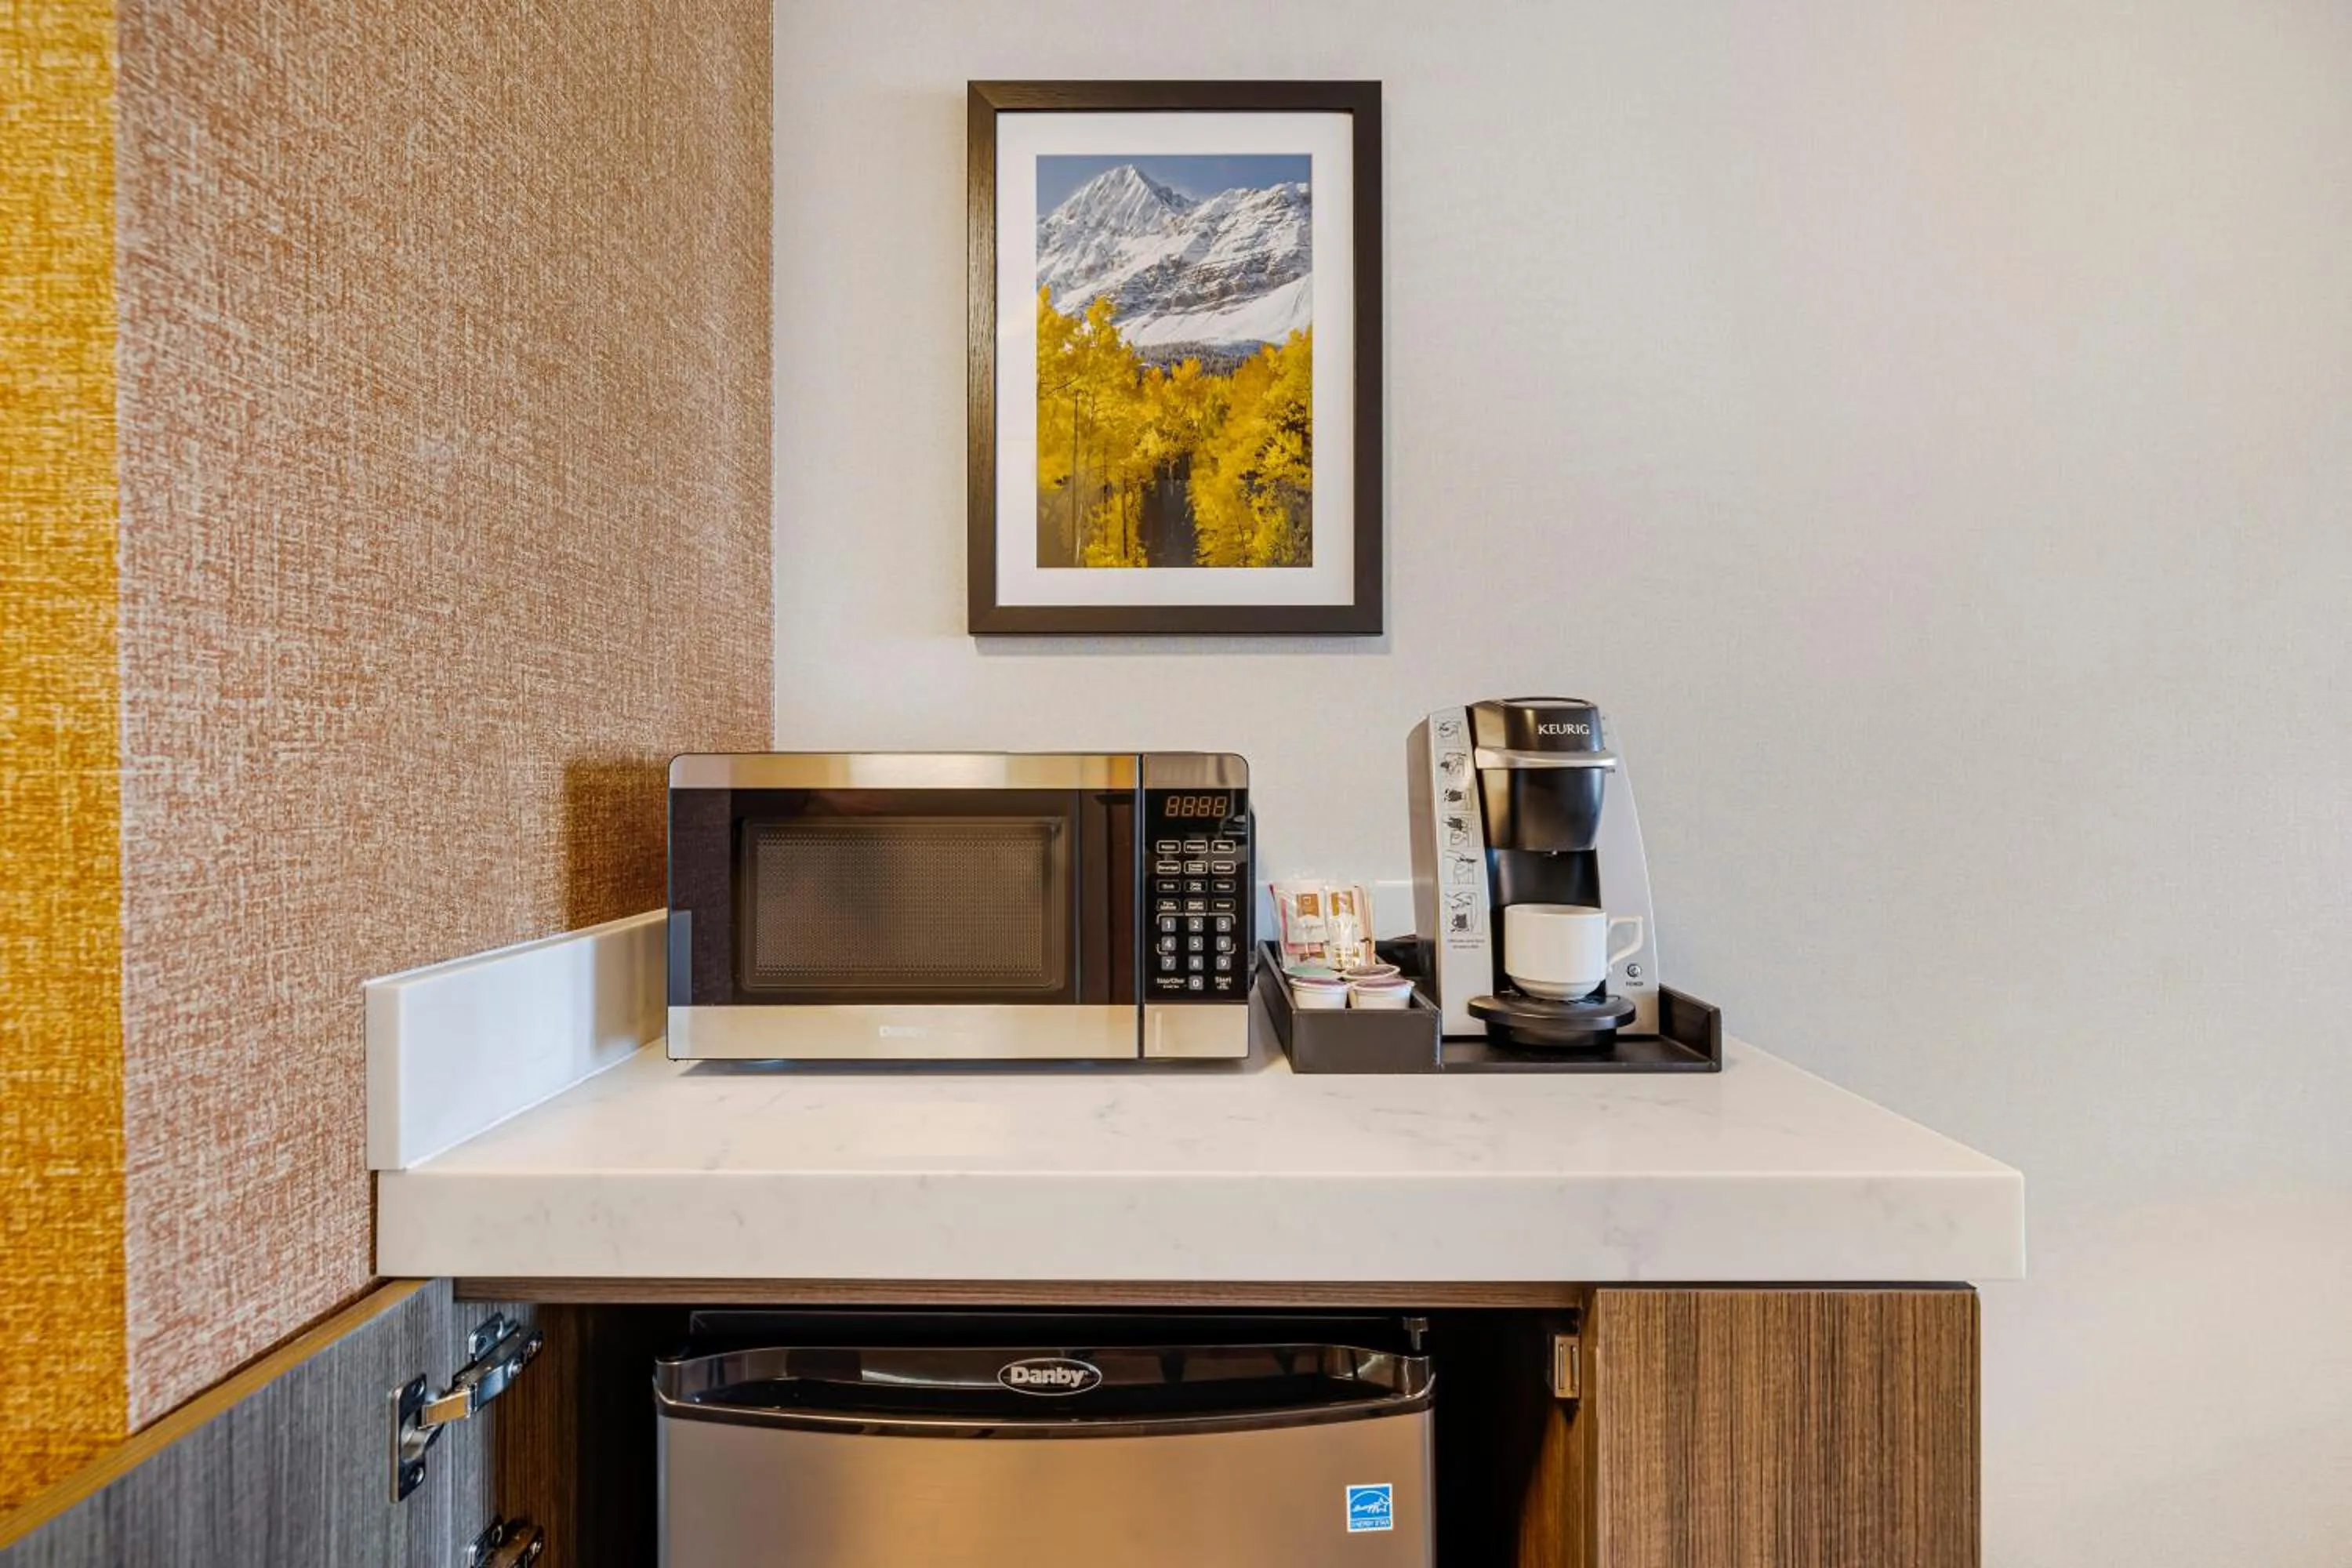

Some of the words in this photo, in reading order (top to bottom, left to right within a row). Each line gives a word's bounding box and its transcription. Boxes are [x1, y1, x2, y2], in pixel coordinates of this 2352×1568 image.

[1537, 724, 1590, 735] KEURIG
[1166, 920, 1171, 929] 1
[1193, 920, 1199, 929] 2
[1221, 920, 1226, 929] 3
[1165, 939, 1172, 948] 4
[1192, 939, 1200, 948] 5
[1221, 939, 1227, 948] 6
[1166, 959, 1172, 967] 7
[1192, 959, 1200, 967] 8
[1221, 959, 1227, 967] 9
[1192, 978, 1200, 987] 0
[1011, 1367, 1087, 1388] Danby
